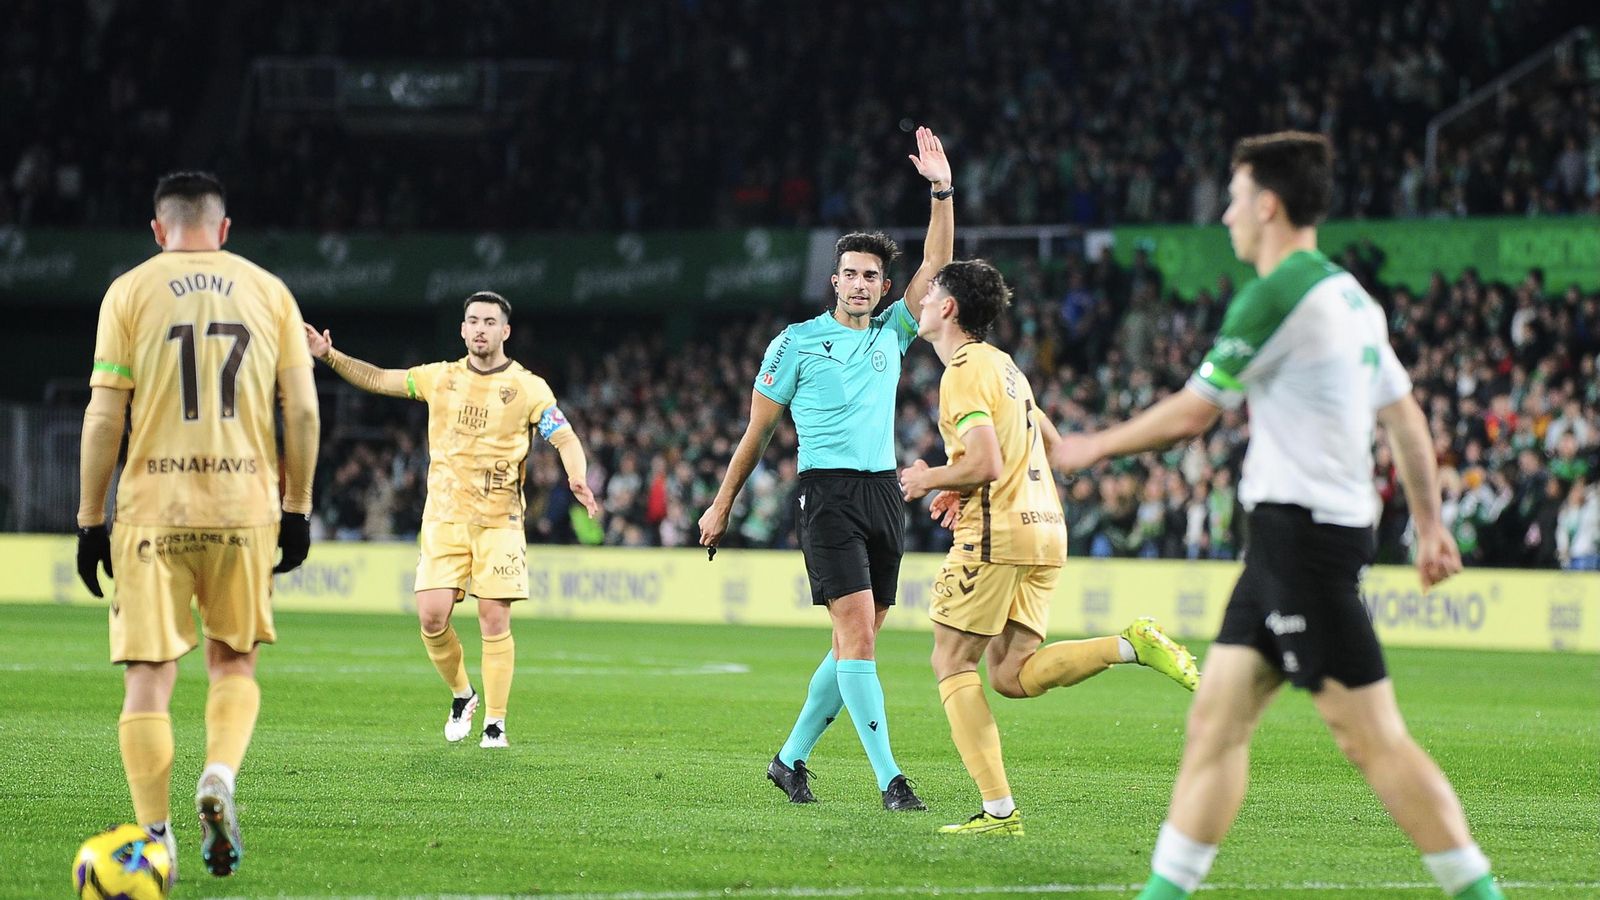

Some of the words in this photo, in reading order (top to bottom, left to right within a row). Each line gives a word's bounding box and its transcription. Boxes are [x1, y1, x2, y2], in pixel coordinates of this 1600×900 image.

[168, 273, 234, 297] DIONI
[167, 321, 251, 421] 17
[457, 409, 487, 430] laga
[464, 403, 489, 419] má
[146, 456, 257, 475] BENAHAVIS
[156, 532, 196, 546] COSTA
[201, 532, 225, 545] DEL
[492, 565, 521, 576] MGS
